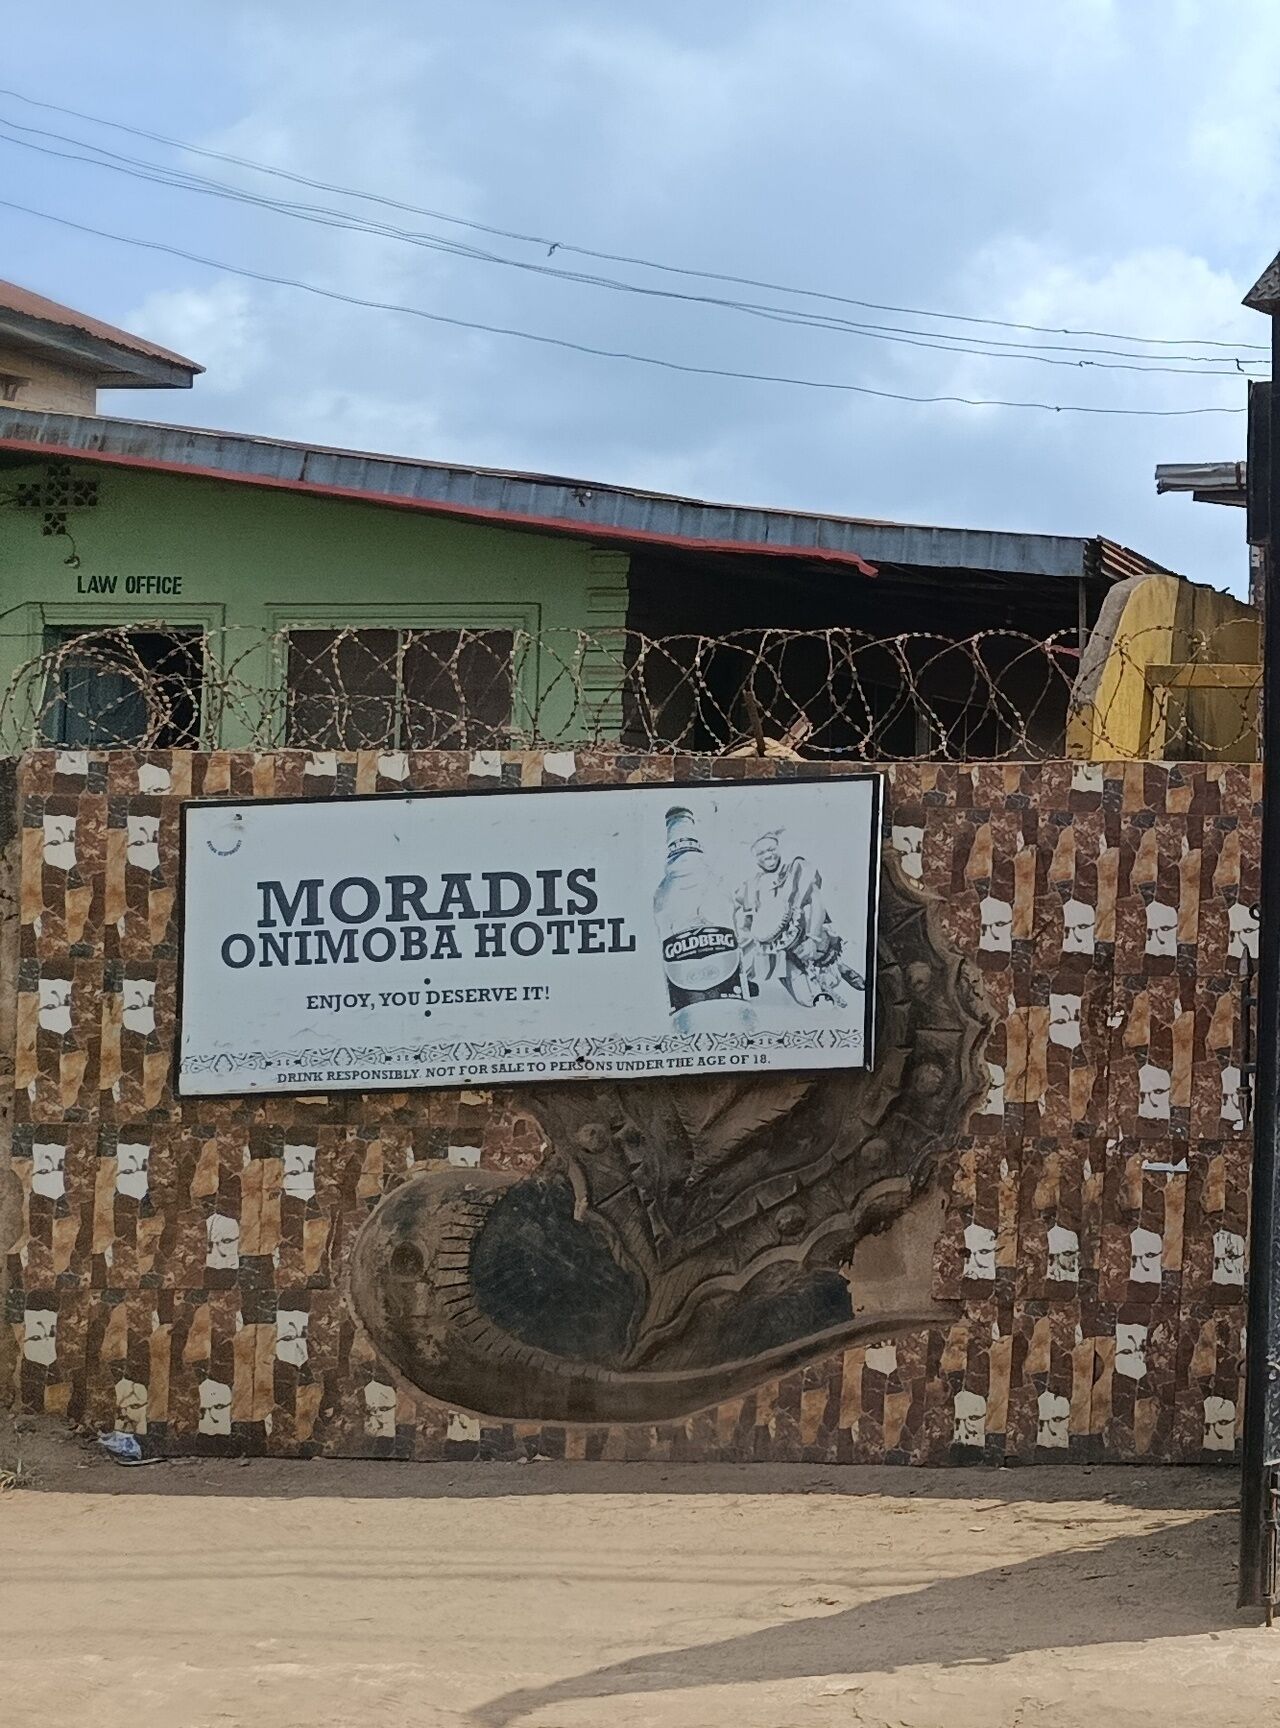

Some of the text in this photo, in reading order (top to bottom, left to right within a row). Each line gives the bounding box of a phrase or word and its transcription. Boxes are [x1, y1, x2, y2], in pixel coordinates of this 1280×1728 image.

[77, 575, 182, 595] LAW OFFICE
[257, 867, 599, 928] MORADIS
[221, 917, 637, 969] ONIMOBA HOTEL
[664, 933, 735, 959] GOLDBERG
[306, 985, 550, 1013] ENJOY, YOU DESERVE IT!
[277, 1071, 324, 1083] DRINK
[426, 1065, 457, 1077] NOT
[459, 1064, 489, 1076] FOR
[491, 1062, 525, 1074] SALE
[527, 1061, 546, 1072] TO
[550, 1060, 613, 1072] PERSONS
[616, 1058, 664, 1071] UNDER
[665, 1057, 694, 1069] THE
[697, 1055, 726, 1067] AGE
[730, 1054, 750, 1065] OF
[753, 1053, 771, 1064] 18.
